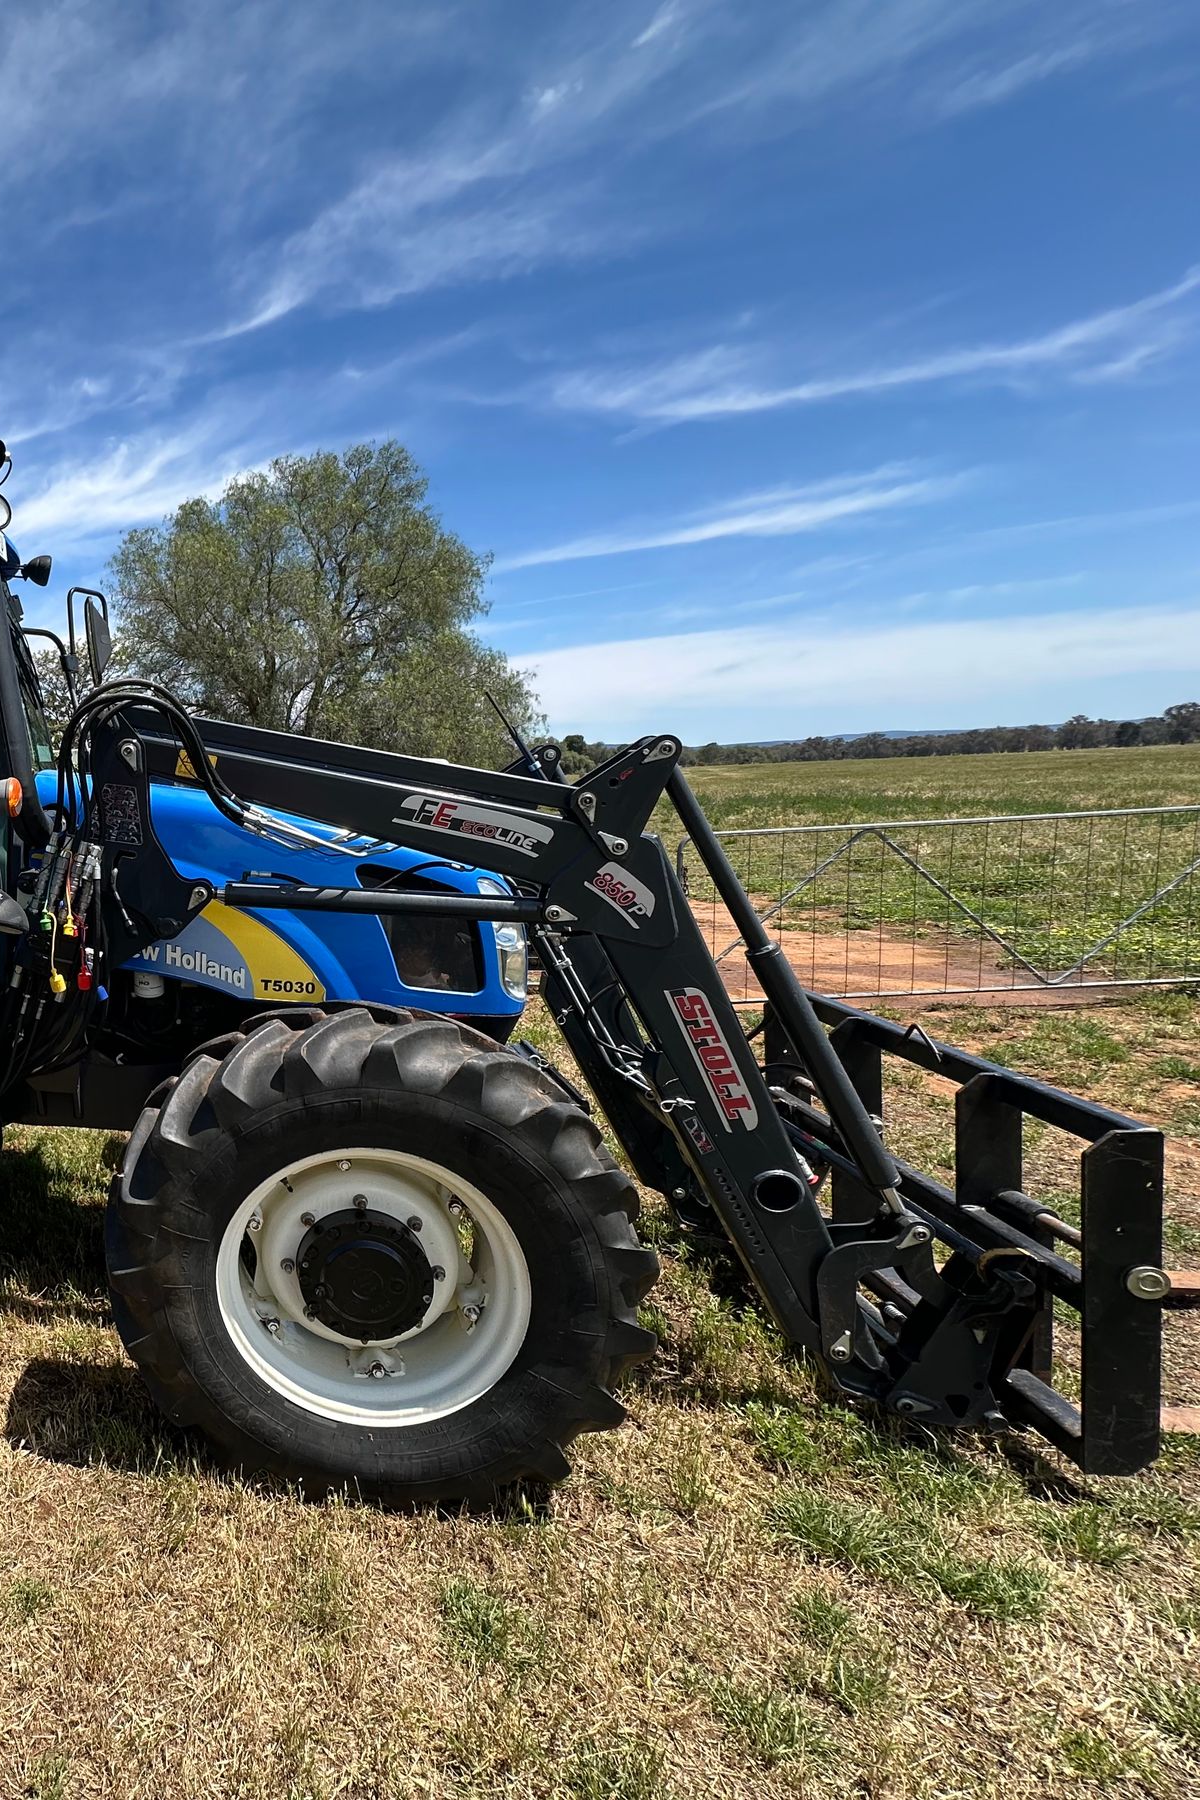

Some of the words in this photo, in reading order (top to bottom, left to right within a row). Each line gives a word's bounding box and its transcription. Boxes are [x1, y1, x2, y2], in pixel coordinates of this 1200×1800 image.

[414, 799, 458, 829] FE
[459, 819, 538, 851] ECOLINE
[166, 944, 246, 989] Holland
[260, 978, 316, 995] T5030
[673, 994, 753, 1120] STOLL
